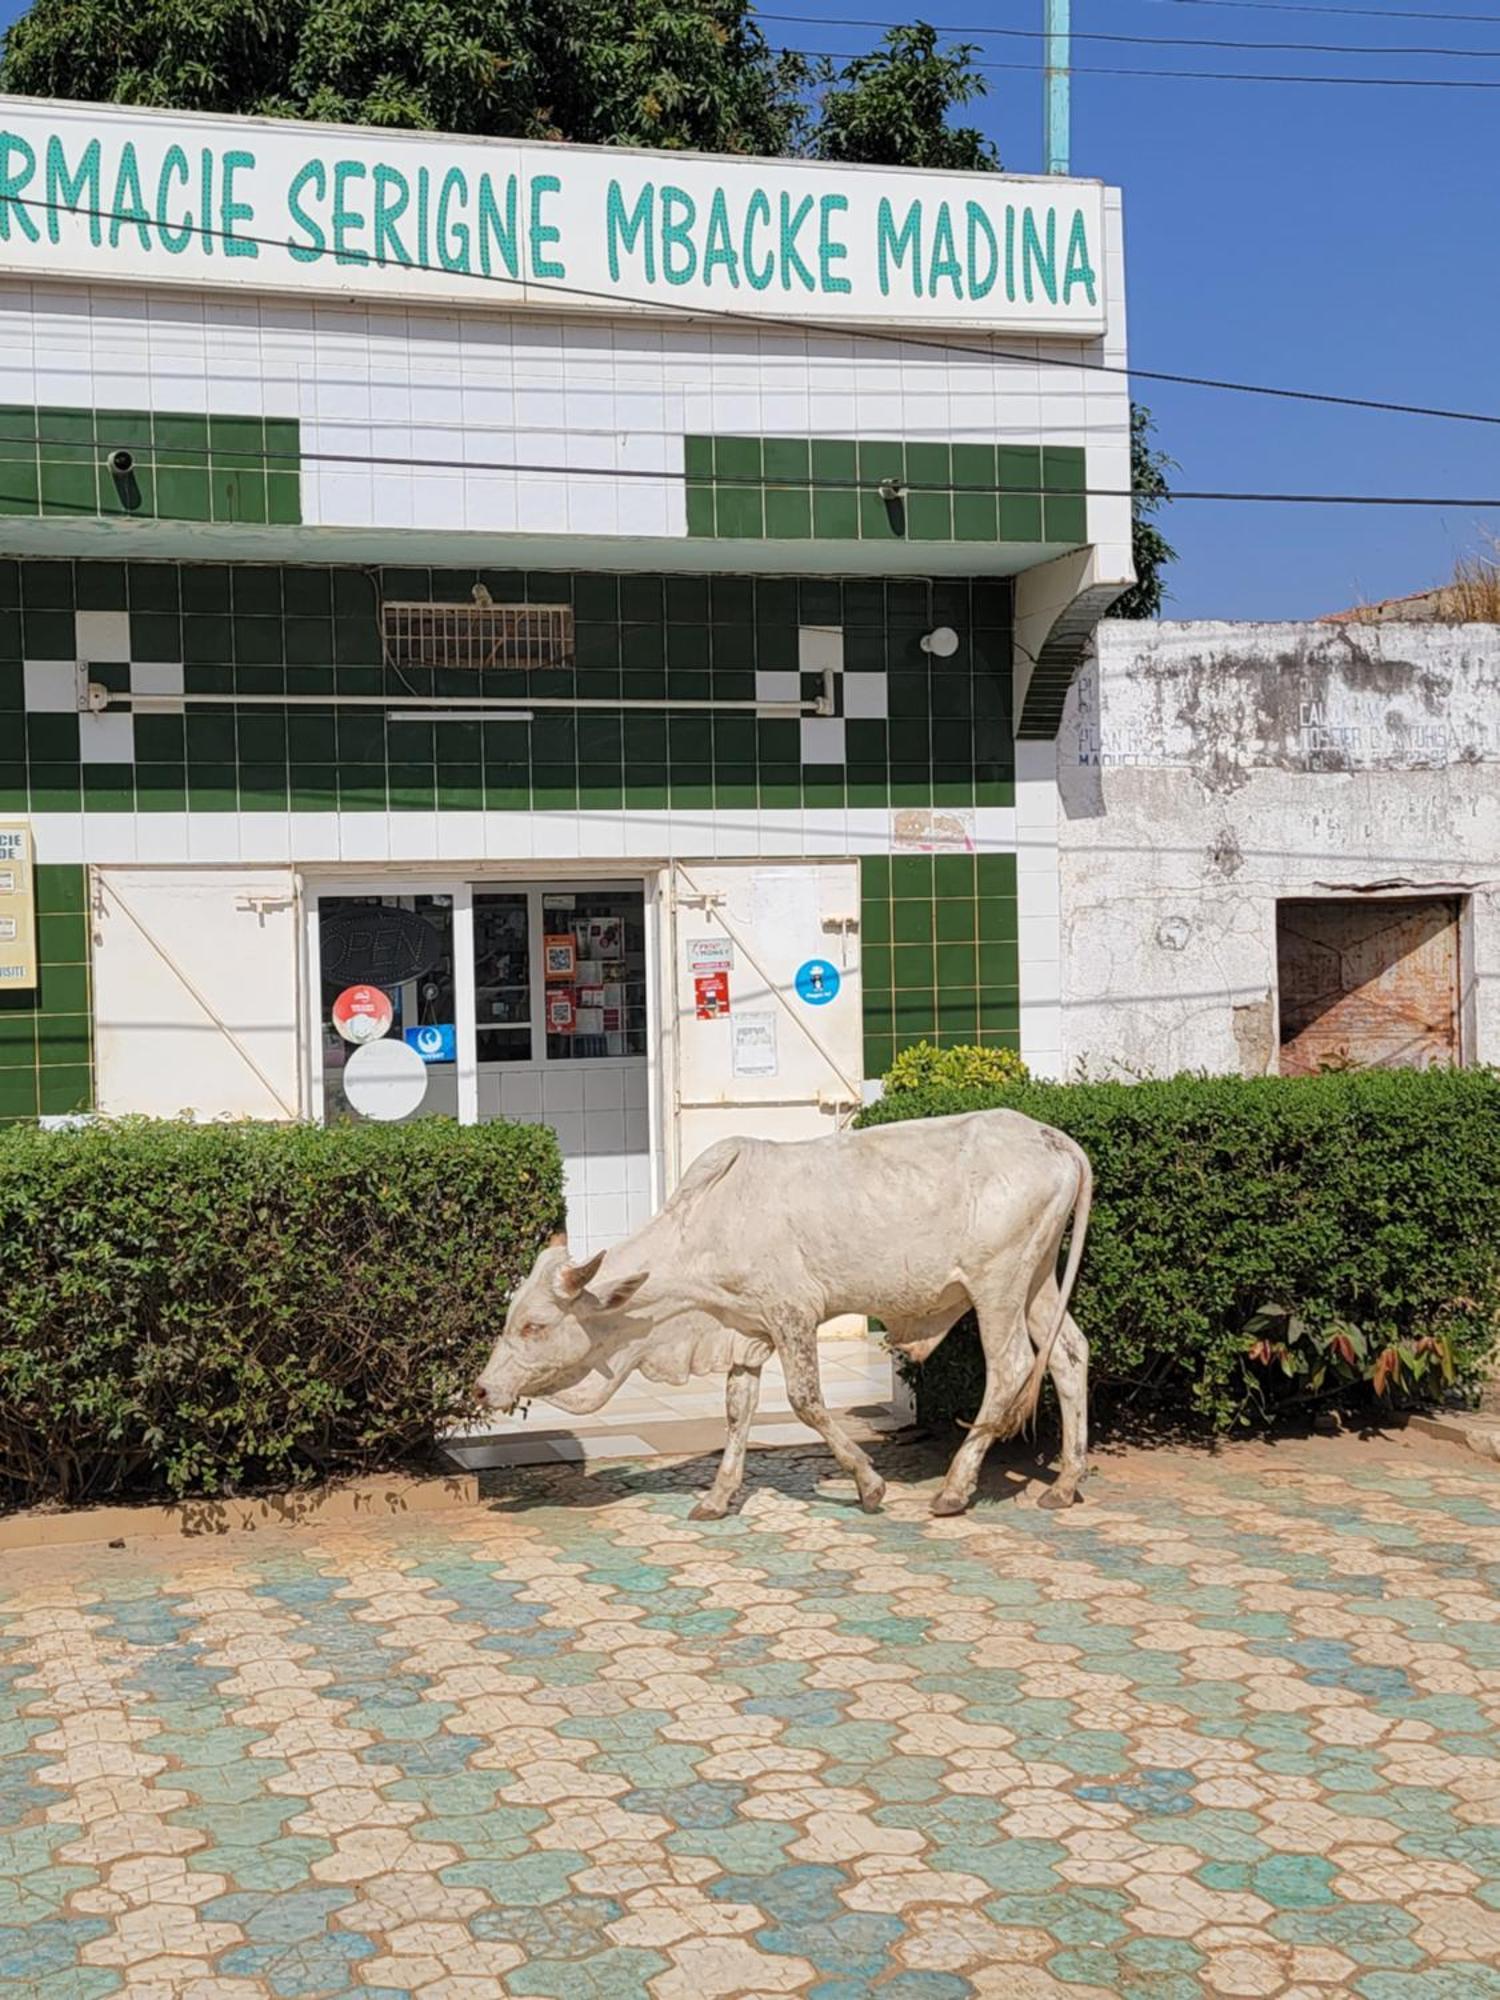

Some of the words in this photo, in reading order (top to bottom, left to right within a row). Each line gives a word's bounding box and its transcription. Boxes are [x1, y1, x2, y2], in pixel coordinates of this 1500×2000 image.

[0, 131, 258, 258] RMACIE
[288, 158, 566, 279] SERIGNE
[606, 179, 852, 293] MBACKE
[878, 197, 1096, 306] MADINA
[320, 927, 425, 970] OPEN
